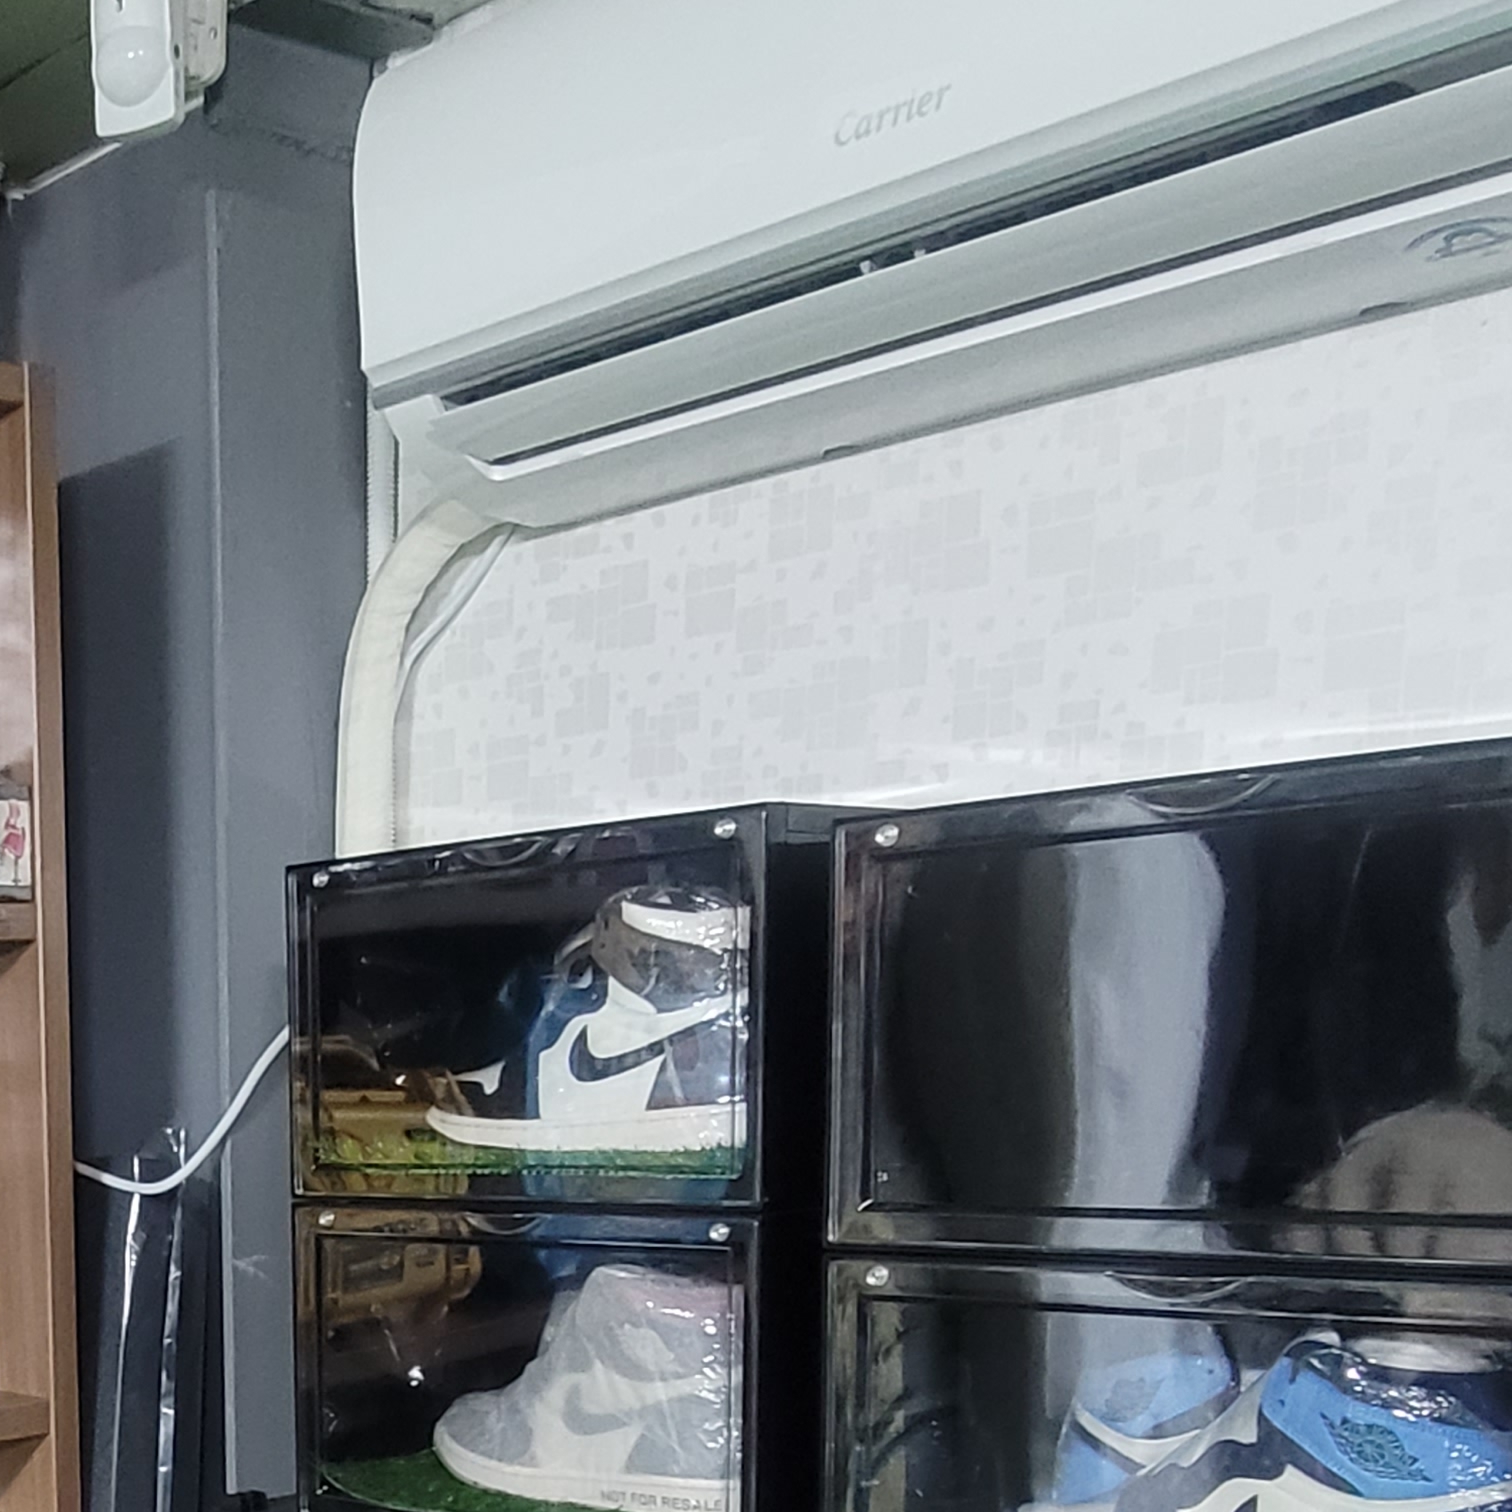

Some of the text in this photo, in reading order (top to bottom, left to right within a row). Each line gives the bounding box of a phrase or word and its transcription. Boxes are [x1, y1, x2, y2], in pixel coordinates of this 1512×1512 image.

[833, 82, 952, 148] Carrier
[601, 1490, 722, 1512] NOT FOR RESALE
